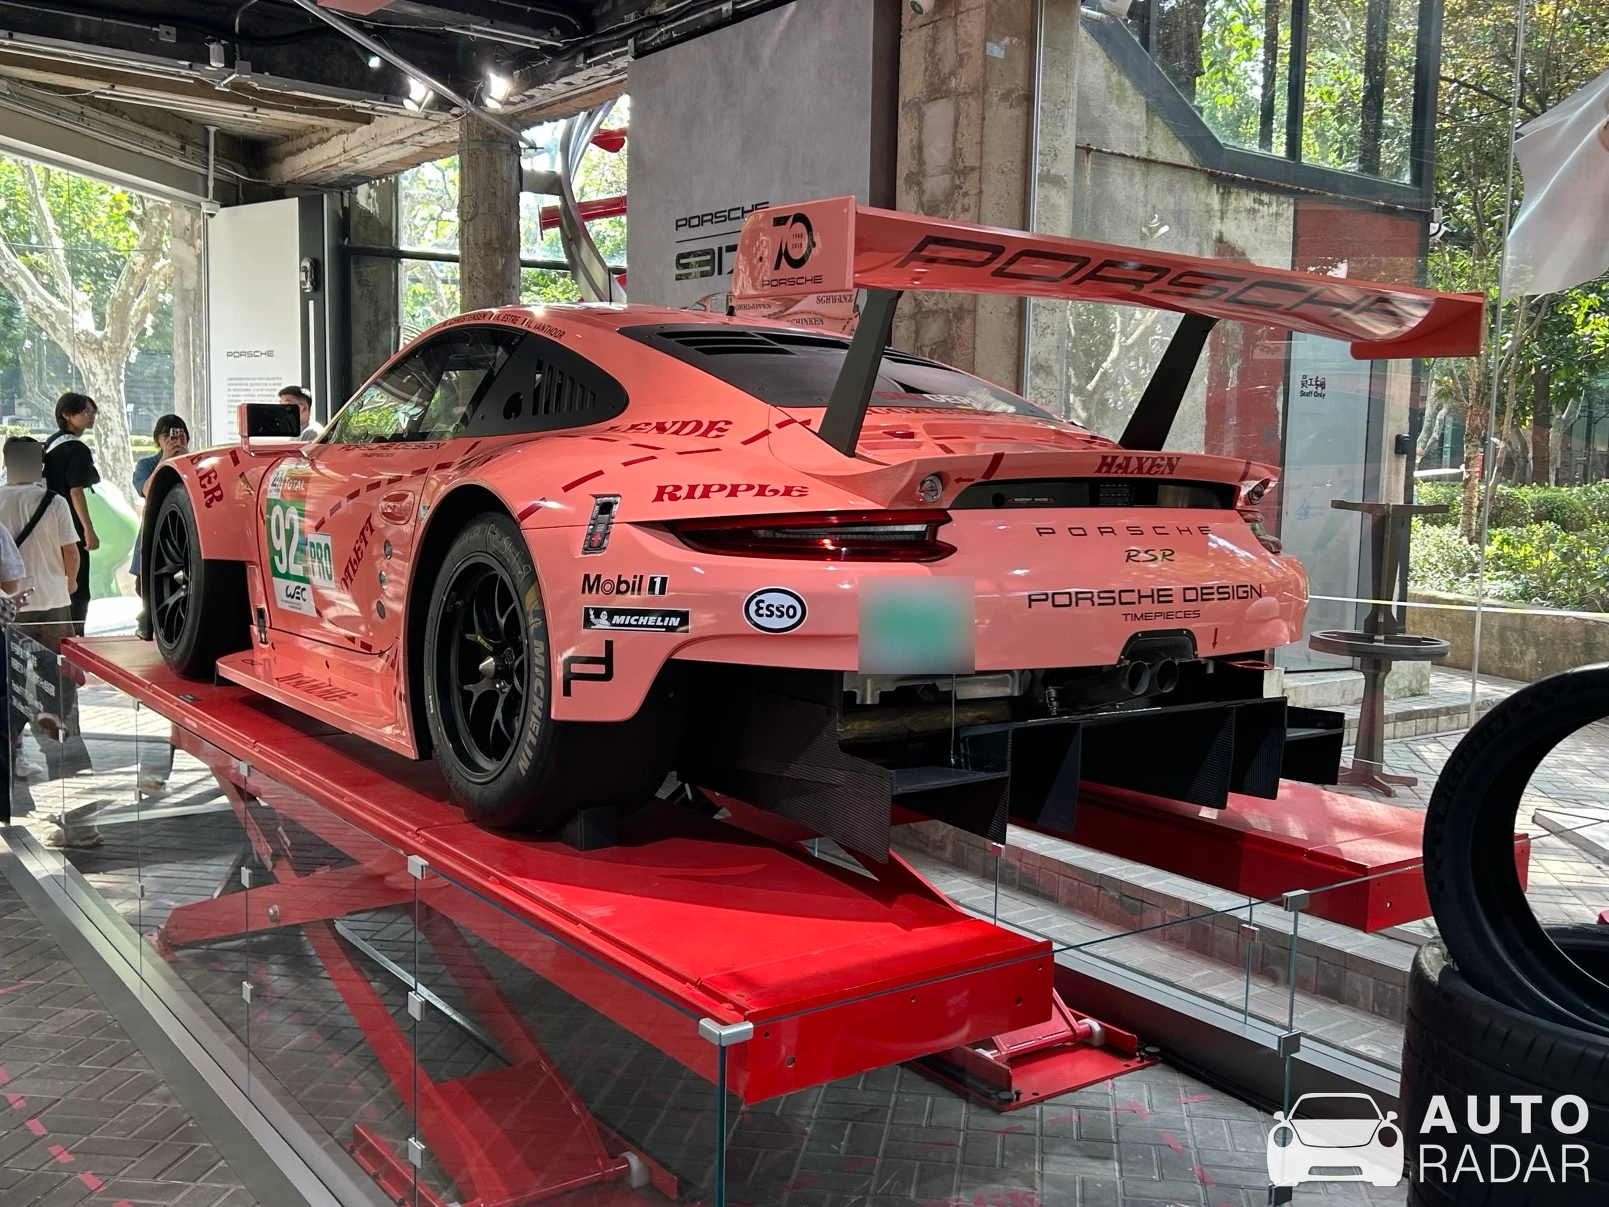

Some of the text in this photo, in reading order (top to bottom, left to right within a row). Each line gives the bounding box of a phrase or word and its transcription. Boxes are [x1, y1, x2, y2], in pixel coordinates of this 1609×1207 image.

[773, 212, 814, 271] 70
[761, 275, 823, 288] PORSCHE
[816, 294, 854, 304] SCHWANZ
[448, 313, 487, 326] CHRISTENSEN
[501, 313, 520, 324] ESTRE
[533, 321, 566, 340] VANTHOOR
[226, 350, 275, 358] PORSCHE
[1301, 374, 1326, 390] 员工专用
[1313, 391, 1326, 399] Only
[1094, 455, 1182, 476] HAXEN
[284, 477, 305, 491] TOTAL
[652, 483, 809, 503] RIPPLE
[1035, 525, 1213, 537] PORSCHE
[271, 504, 304, 576] 92
[309, 541, 333, 582] PRO
[1125, 549, 1175, 562] RSR
[581, 574, 643, 596] Mobil
[285, 585, 306, 602] WEC
[1028, 584, 1262, 608] PORSCHE DESIGN
[754, 599, 798, 620] Esso
[1122, 610, 1200, 622] TIMEPIECES
[612, 614, 681, 626] MICHELIN
[518, 639, 545, 777] MICHELIN
